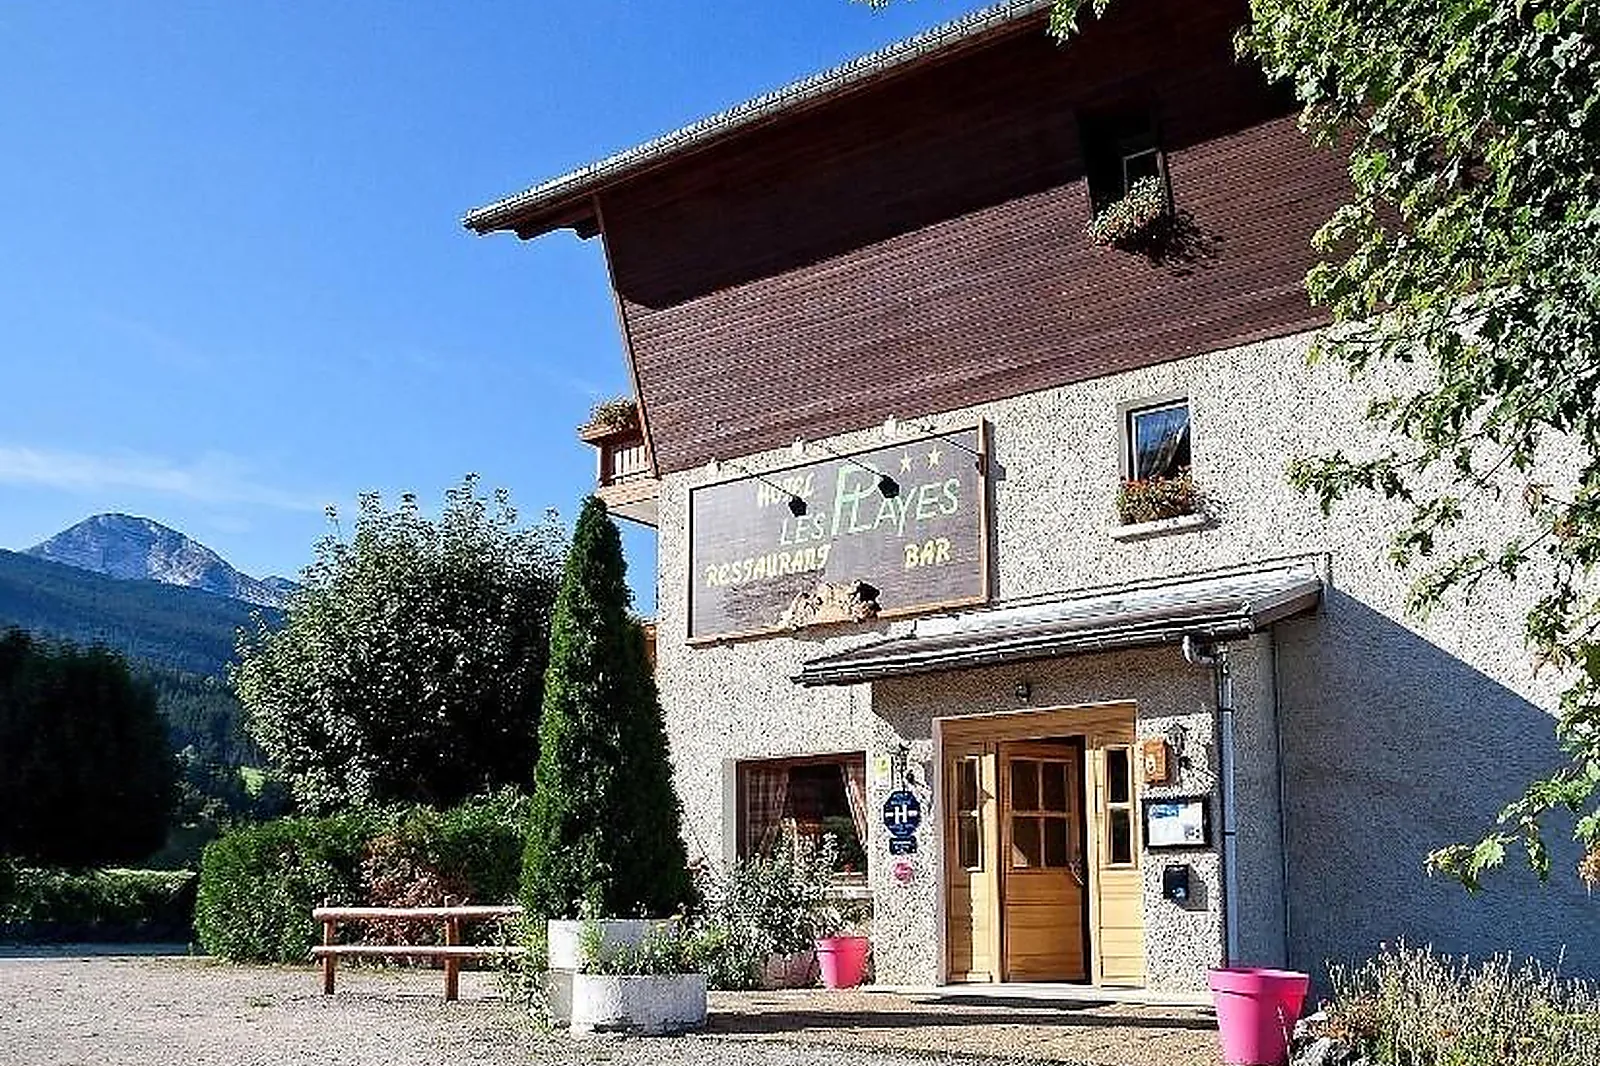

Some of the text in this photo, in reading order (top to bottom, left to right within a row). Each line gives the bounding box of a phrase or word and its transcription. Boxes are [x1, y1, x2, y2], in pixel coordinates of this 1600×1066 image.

[780, 462, 960, 545] LES PLAYES
[903, 538, 951, 568] BAR
